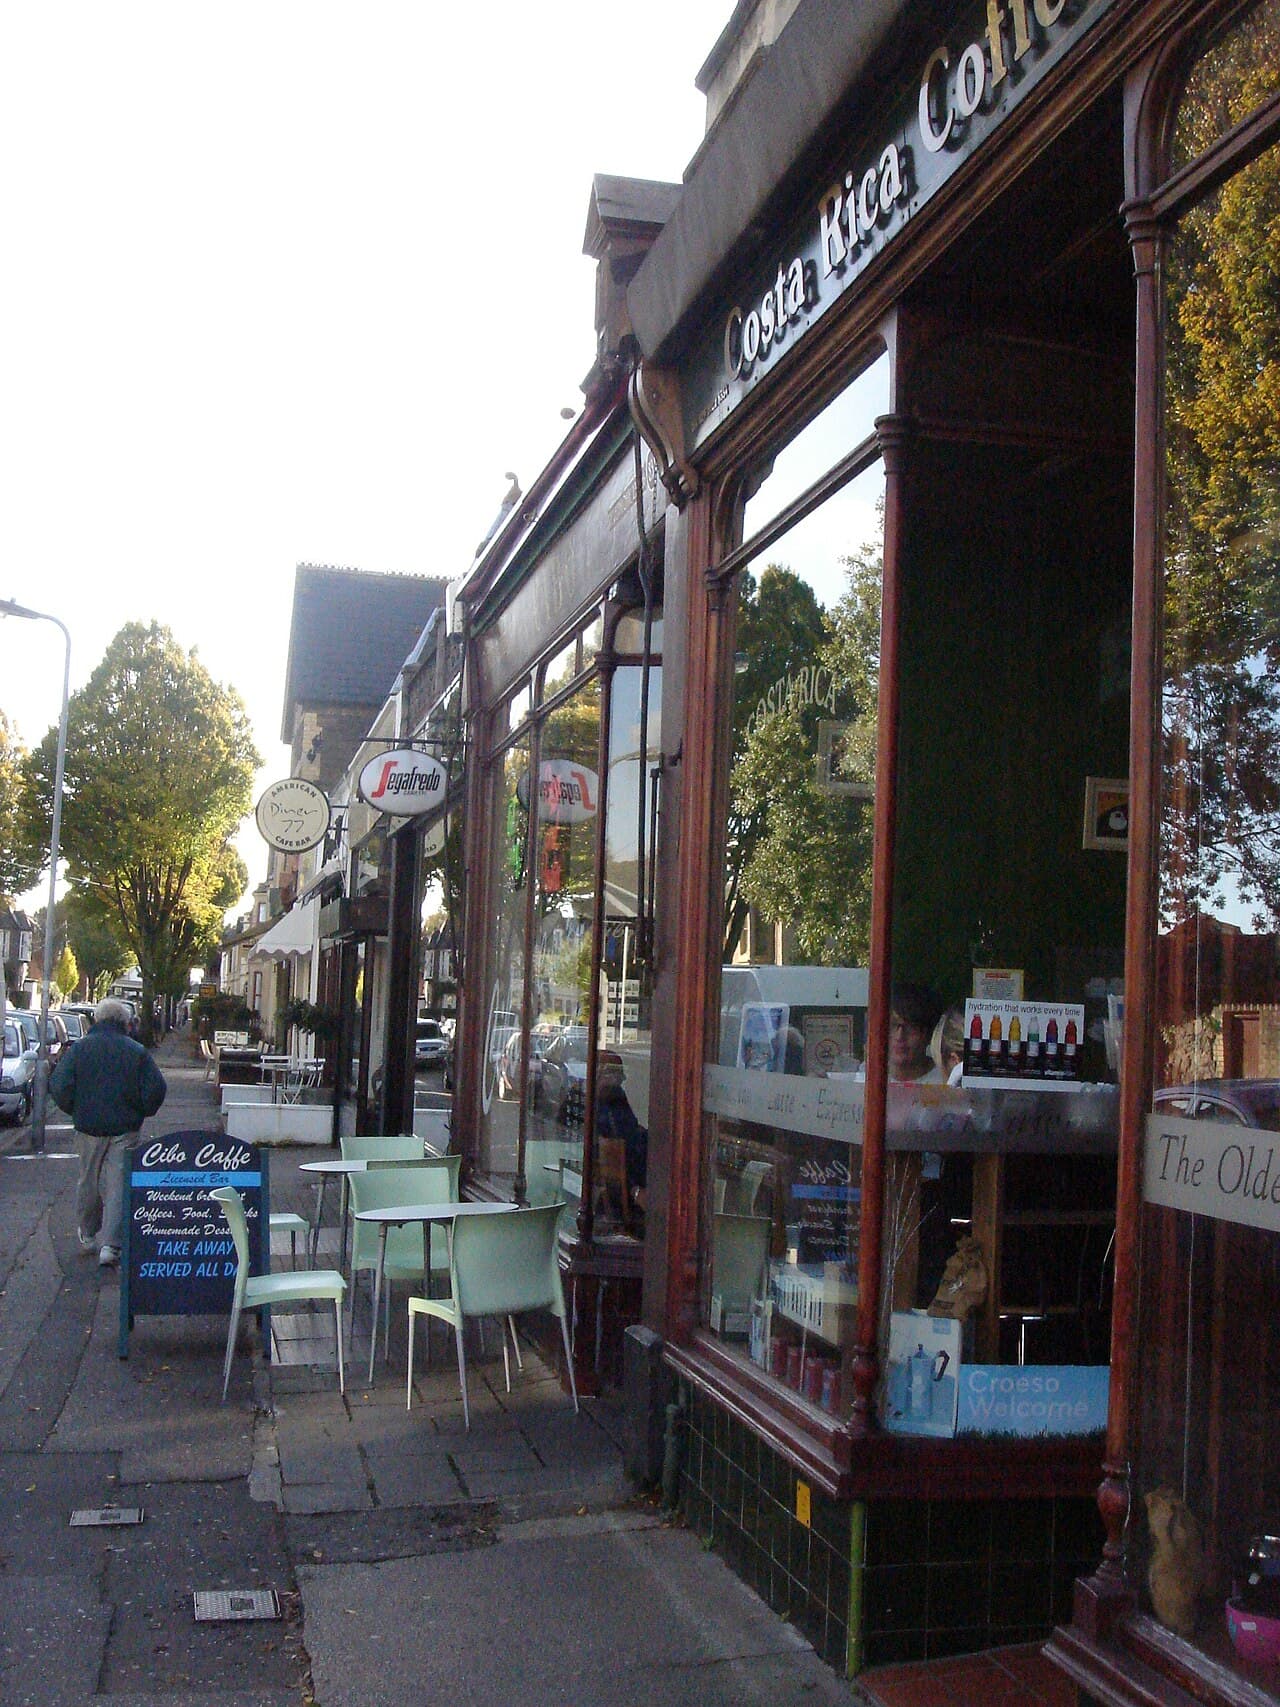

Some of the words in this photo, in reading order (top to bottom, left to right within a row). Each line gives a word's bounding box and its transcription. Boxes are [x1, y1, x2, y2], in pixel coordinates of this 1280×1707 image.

[724, 256, 806, 382] Costa
[818, 143, 902, 280] Rica
[371, 761, 441, 798] Segafredo
[271, 783, 317, 798] AMERICAN
[270, 801, 318, 816] Diner
[280, 819, 305, 833] 77
[275, 835, 294, 847] CAFE
[296, 835, 312, 847] BAR
[968, 1002, 1003, 1013] hydration
[1004, 1004, 1019, 1013] that
[1064, 1007, 1081, 1016] time
[141, 1143, 187, 1167] Cibo
[1159, 1133, 1205, 1187] The
[160, 1172, 206, 1184] Licensed
[209, 1172, 230, 1184] Bar
[146, 1190, 193, 1202] Weekend
[140, 1223, 201, 1236] Homemade
[157, 1241, 191, 1256] TAKE
[193, 1241, 236, 1256] AWAY
[139, 1262, 192, 1278] SERVED
[195, 1262, 219, 1277] ALL
[968, 1369, 1060, 1394] Croeso
[967, 1395, 1089, 1419] Welcome
